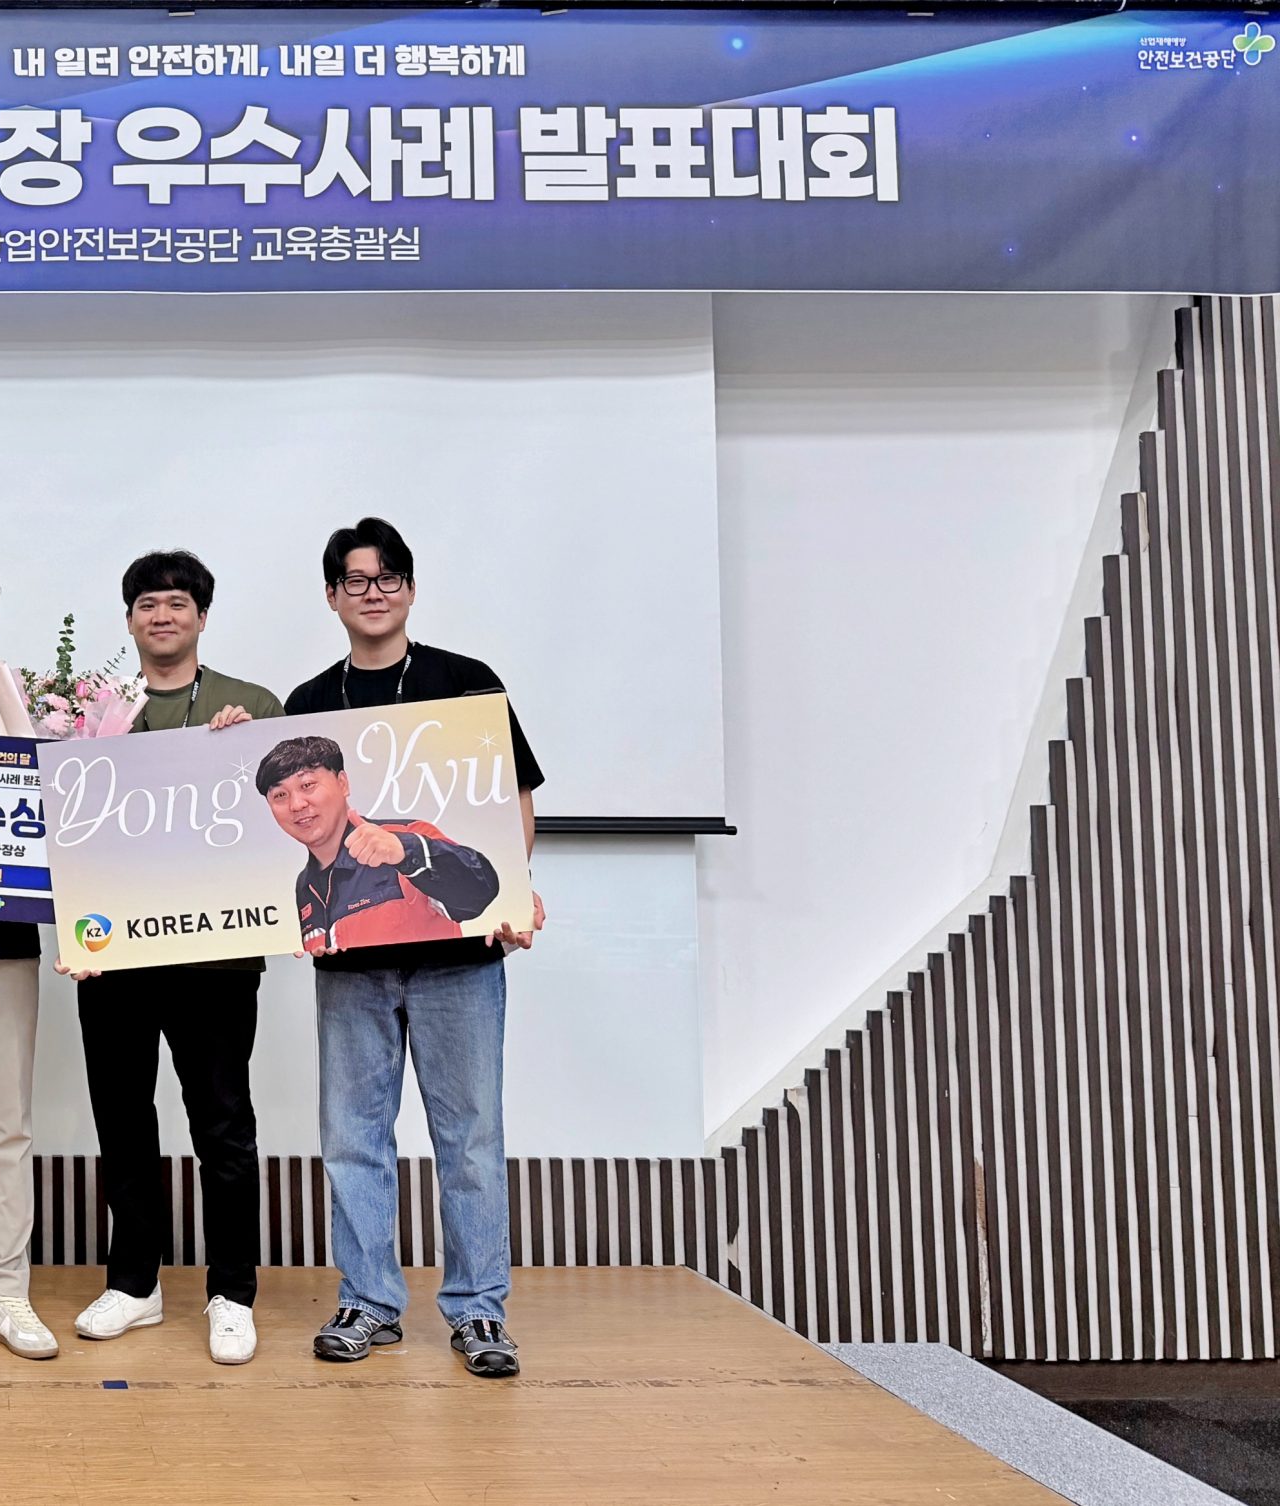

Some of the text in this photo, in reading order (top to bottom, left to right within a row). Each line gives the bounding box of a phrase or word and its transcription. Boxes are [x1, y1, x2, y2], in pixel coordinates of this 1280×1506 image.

[13, 44, 525, 78] 내 일터 안전하게, 내일 더 행복하게
[1137, 49, 1237, 70] 안전보건공단
[112, 105, 495, 206] 우수사례
[519, 106, 899, 203] 발표대회
[250, 225, 420, 263] 교육총괄실
[20, 753, 31, 766] 달
[54, 720, 510, 848] Dong Kyu
[86, 927, 102, 938] KZ
[126, 905, 279, 939] KOREA ZINC
